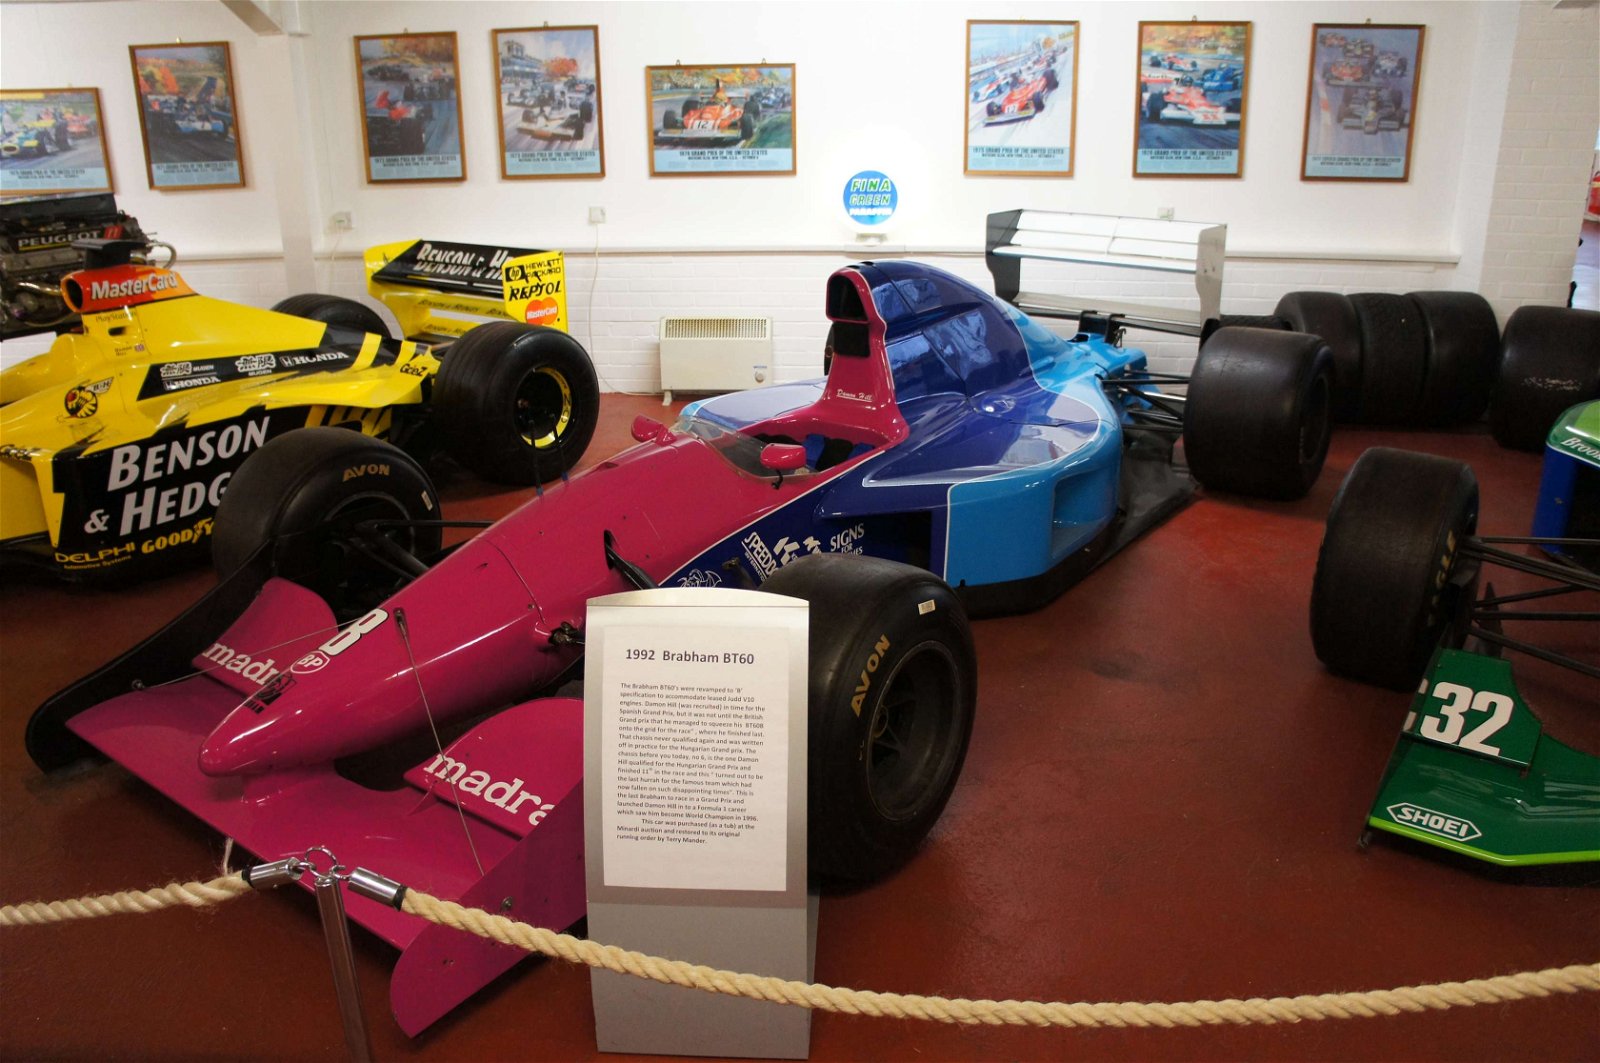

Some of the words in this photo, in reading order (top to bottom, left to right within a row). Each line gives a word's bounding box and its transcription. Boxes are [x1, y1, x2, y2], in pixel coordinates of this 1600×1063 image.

[850, 178, 891, 192] FINA
[849, 194, 890, 206] GREEN
[18, 231, 100, 248] PEUGEOT
[92, 272, 178, 300] MasterCard
[509, 280, 561, 301] REPSOL
[294, 352, 349, 365] HONDA
[174, 376, 221, 388] HONDA
[108, 416, 270, 492] BENSON
[343, 464, 390, 482] AVON
[84, 509, 110, 534] &
[831, 523, 864, 552] SIGNS
[55, 542, 135, 563] DELPHI
[318, 608, 389, 656] 8
[298, 654, 324, 668] BP
[626, 649, 654, 660] 1992
[663, 651, 718, 663] Brabham
[724, 653, 754, 664] BT60
[851, 634, 890, 717] AVON
[620, 690, 656, 700] specification
[665, 692, 706, 700] accommodate
[697, 685, 726, 695] revamped
[620, 698, 643, 708] engines.
[678, 701, 691, 710] (was
[694, 702, 722, 711] recruited)
[620, 707, 641, 716] Spanish
[662, 709, 675, 717] Prix,
[1420, 681, 1514, 756] 32
[638, 716, 649, 725] prix
[673, 718, 699, 727] managed
[645, 725, 656, 734] grid
[672, 735, 697, 744] qualified
[700, 736, 715, 745] again
[635, 742, 658, 751] practice
[680, 744, 710, 754] Hungarian
[731, 746, 744, 755] prix.
[672, 752, 690, 761] today,
[629, 758, 654, 768] qualified
[677, 761, 706, 770] Hungarian
[640, 792, 666, 800] Brabham
[672, 786, 711, 796] disappointing
[617, 800, 643, 808] launched
[705, 812, 734, 822] Champion
[1397, 807, 1469, 837] SHOEI
[678, 819, 708, 829] purchased
[724, 821, 736, 830] tub)
[617, 833, 639, 842] running
[666, 835, 681, 844] Terry
[718, 829, 740, 839] original
